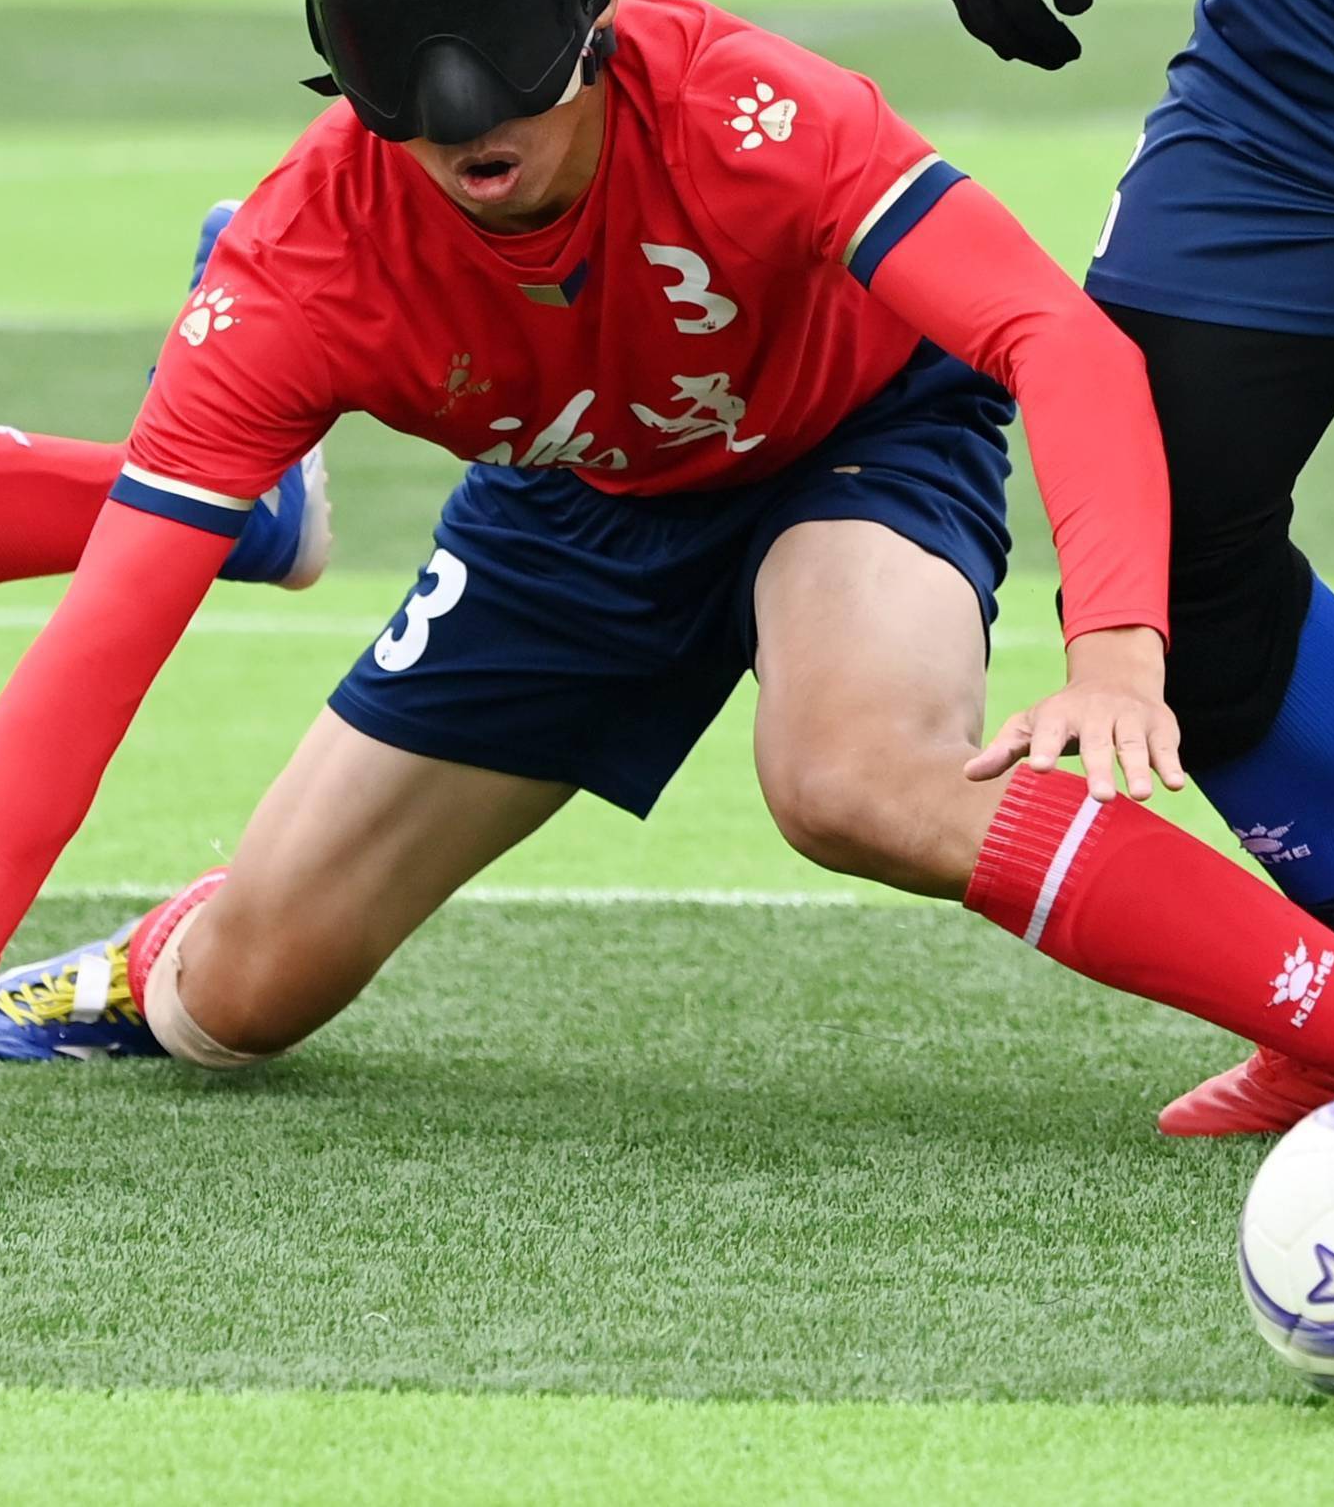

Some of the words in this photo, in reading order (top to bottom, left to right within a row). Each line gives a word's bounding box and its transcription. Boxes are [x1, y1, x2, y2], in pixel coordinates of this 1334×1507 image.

[640, 242, 739, 335] 3
[374, 548, 468, 673] 3
[1256, 843, 1313, 865] LME
